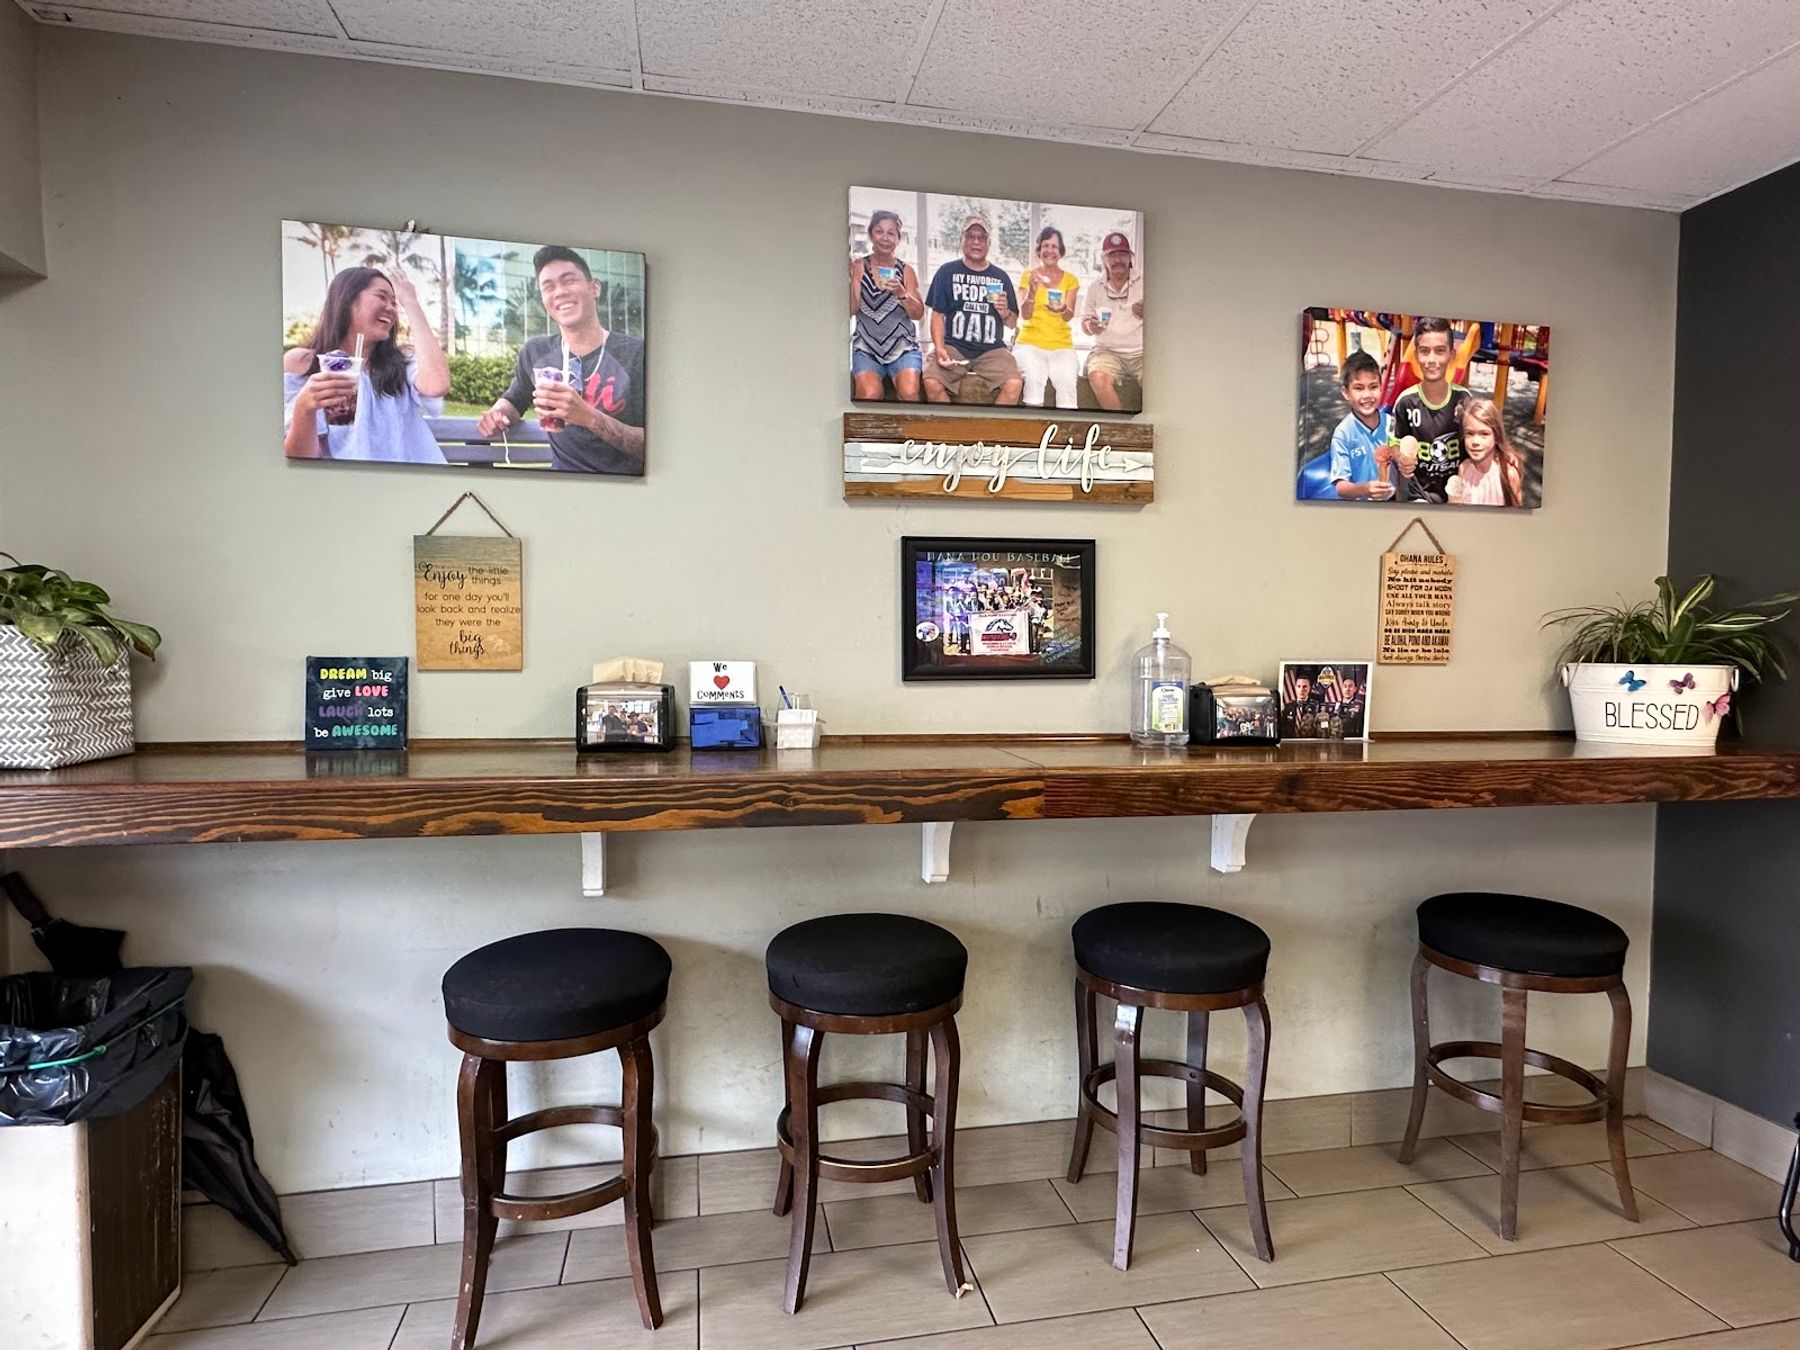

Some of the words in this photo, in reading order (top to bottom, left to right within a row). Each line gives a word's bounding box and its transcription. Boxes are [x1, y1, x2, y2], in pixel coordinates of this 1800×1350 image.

[953, 274, 965, 284] MY
[952, 283, 987, 302] PEOP
[952, 311, 996, 344] DAD
[901, 439, 1012, 492] enjoy
[1037, 424, 1113, 493] life
[1399, 554, 1422, 563] OHANA
[1423, 555, 1444, 564] RULES
[418, 562, 466, 589] Enjoy
[468, 566, 484, 575] the
[488, 566, 509, 575] little
[471, 576, 502, 586] things
[425, 592, 438, 601] for
[442, 593, 461, 601] one
[465, 592, 482, 603] day
[486, 592, 510, 602] you'll
[1386, 600, 1414, 609] Always
[1415, 600, 1430, 608] talk
[1432, 601, 1451, 609] story
[416, 604, 436, 614] look
[440, 604, 463, 614] back
[468, 605, 486, 614] and
[490, 605, 520, 614] realize
[435, 618, 455, 628] they
[460, 619, 482, 627] were
[486, 618, 501, 627] the
[459, 629, 483, 645] big
[449, 641, 485, 660] things
[713, 662, 728, 673] We
[320, 668, 367, 680] DREAM
[371, 670, 392, 682] big
[322, 687, 351, 700] give
[354, 685, 389, 697] LOVE
[318, 705, 363, 718] LAUGH
[367, 706, 393, 717] lots
[1604, 701, 1699, 731] BLESSED
[313, 726, 329, 738] be
[332, 724, 398, 737] AWESOME
